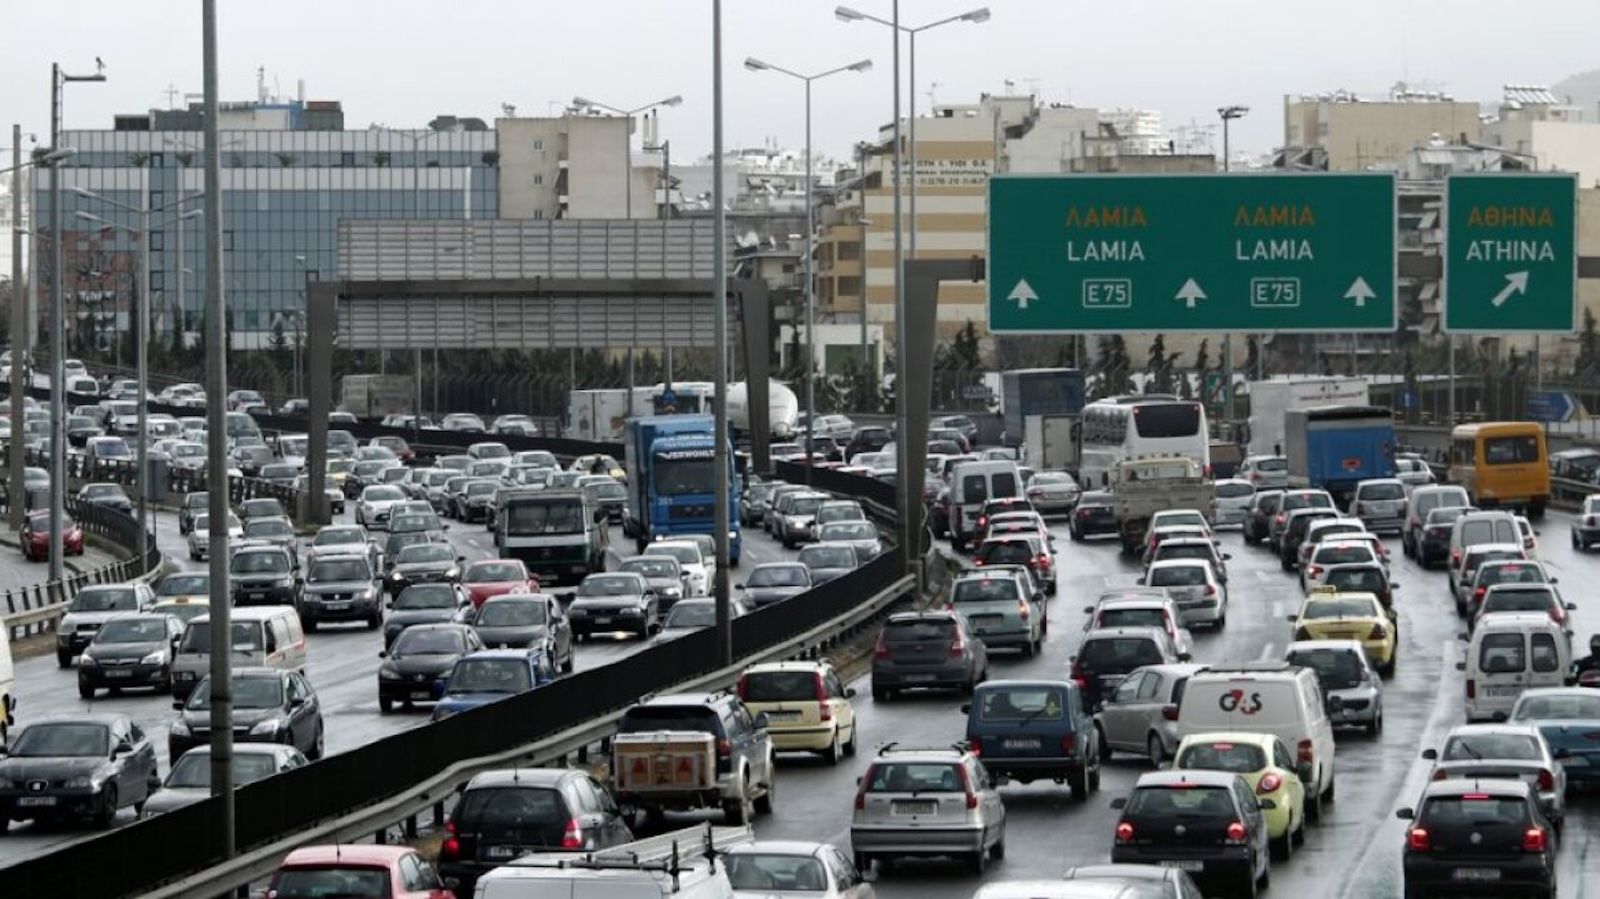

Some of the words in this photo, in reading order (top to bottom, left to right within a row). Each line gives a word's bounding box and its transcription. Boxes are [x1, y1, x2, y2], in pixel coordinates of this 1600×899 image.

[1064, 204, 1146, 228] ΛΑΜΙΑ
[1234, 204, 1315, 227] ΛΑΜΙΑ
[1467, 204, 1554, 228] ΑΘΗΝΑ
[1067, 240, 1145, 261] LAMIA
[1236, 239, 1314, 260] LAMIA
[1466, 240, 1555, 261] ATHINA
